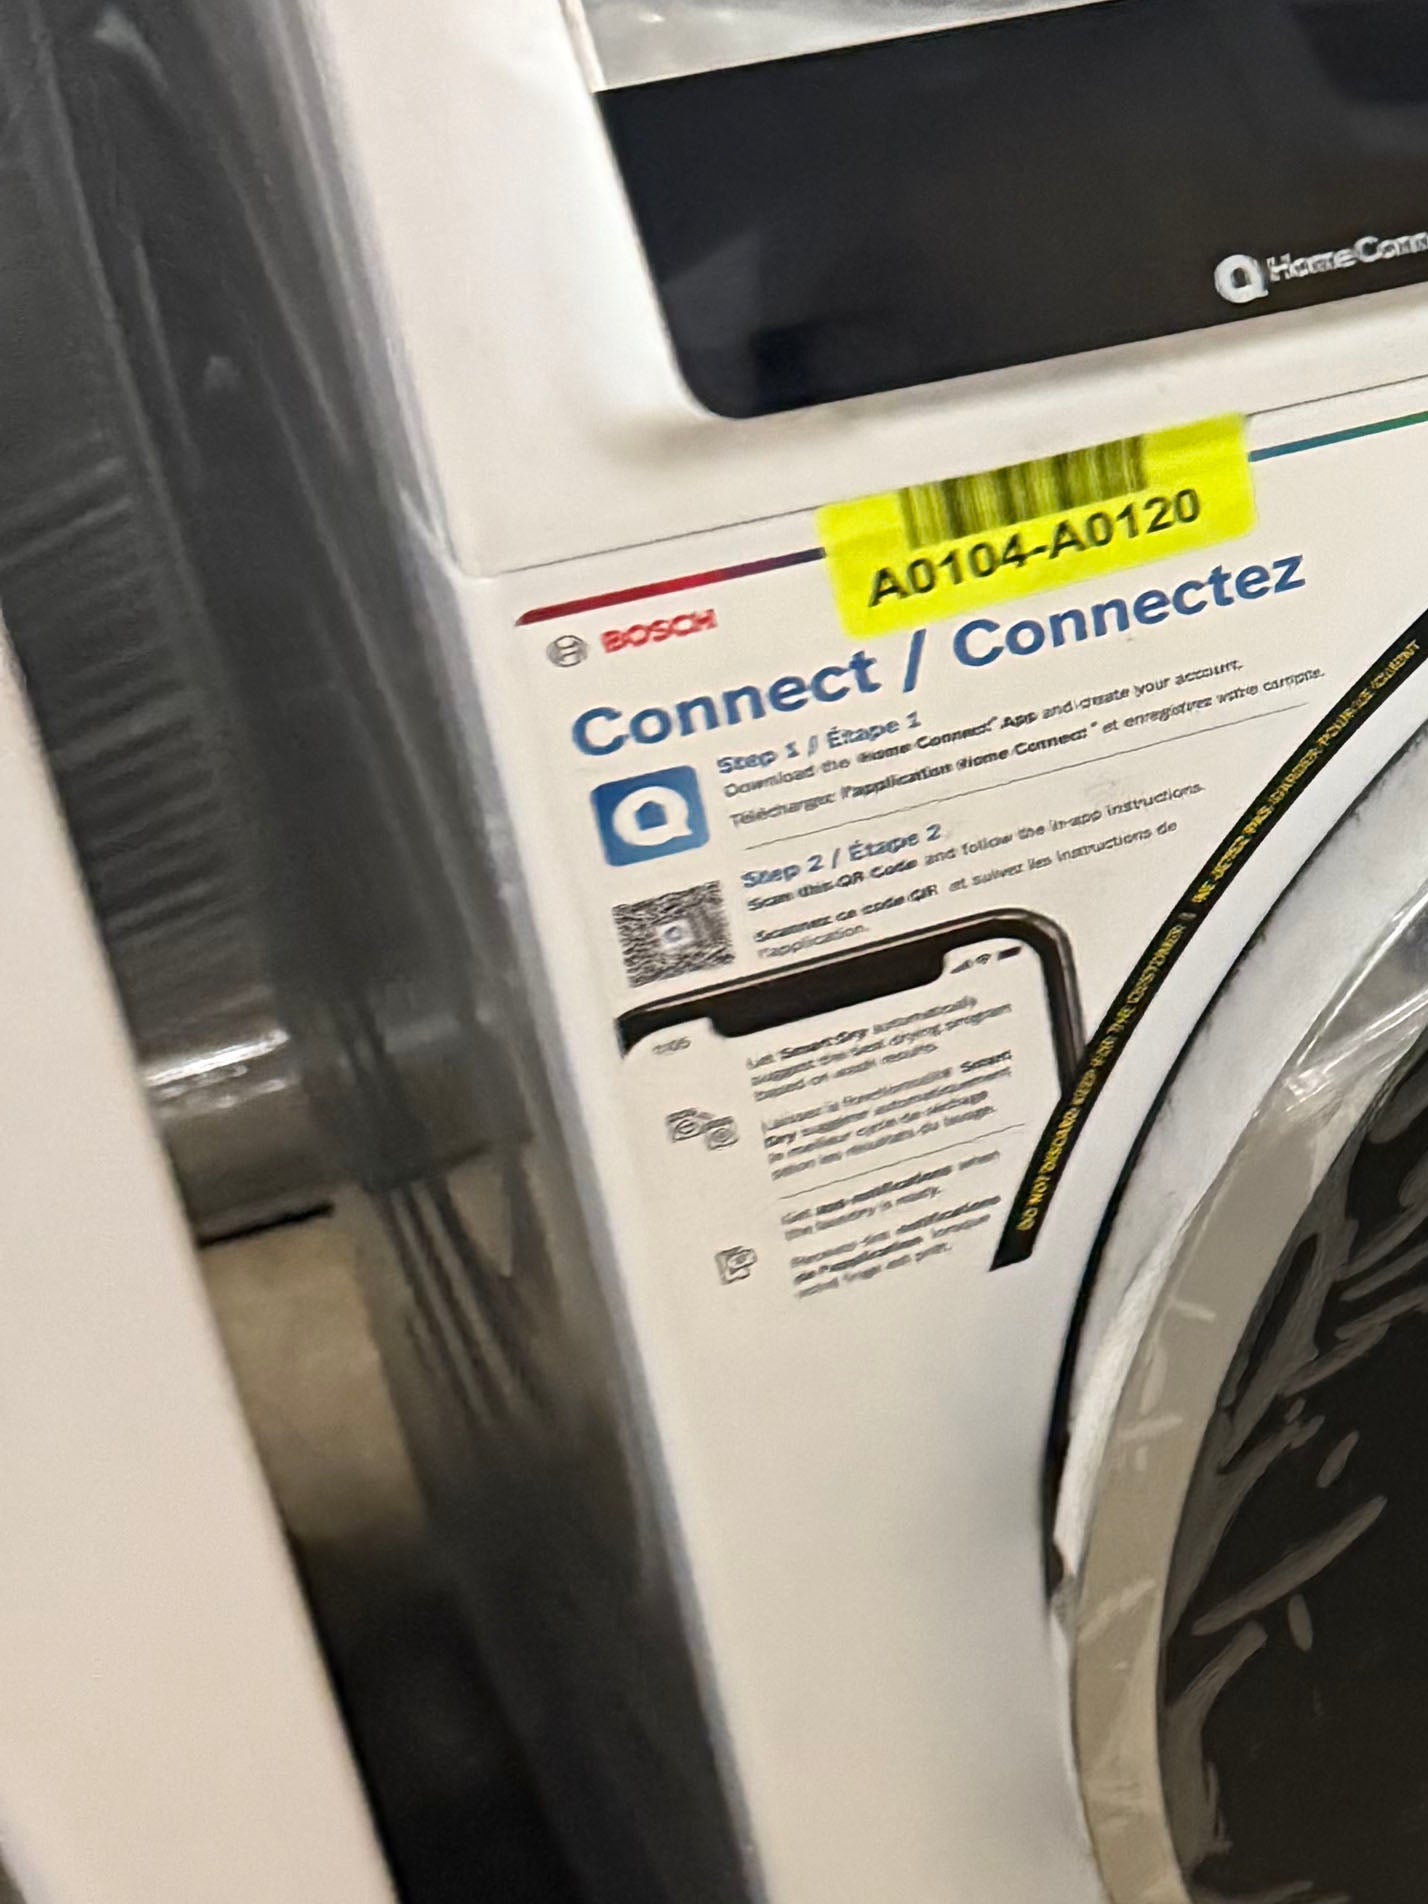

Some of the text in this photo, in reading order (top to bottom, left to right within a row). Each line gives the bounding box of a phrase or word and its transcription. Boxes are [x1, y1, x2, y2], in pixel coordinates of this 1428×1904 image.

[868, 488, 1200, 608] A0104-A0120
[573, 554, 1306, 756] Connect / Connectez
[601, 609, 717, 653] BOSCH
[717, 750, 777, 774] Step
[785, 741, 800, 758] 1
[827, 720, 899, 749] Étape
[906, 711, 921, 729] 1
[724, 766, 814, 797] Download
[1001, 710, 1038, 730] App
[1042, 701, 1073, 720] and
[1078, 688, 1129, 709] create
[1134, 678, 1168, 698] your
[1102, 719, 1119, 734] et
[741, 823, 942, 888] Step 2 / Étape 2
[870, 857, 917, 878] Code
[925, 848, 956, 865] and
[961, 835, 1012, 856] follow
[1018, 825, 1045, 841] the
[1106, 783, 1206, 816] instructions.
[1057, 829, 1152, 863] instructions
[1156, 819, 1177, 837] de
[1017, 1208, 1038, 1231] DO
[1029, 1175, 1050, 1206] NOT
